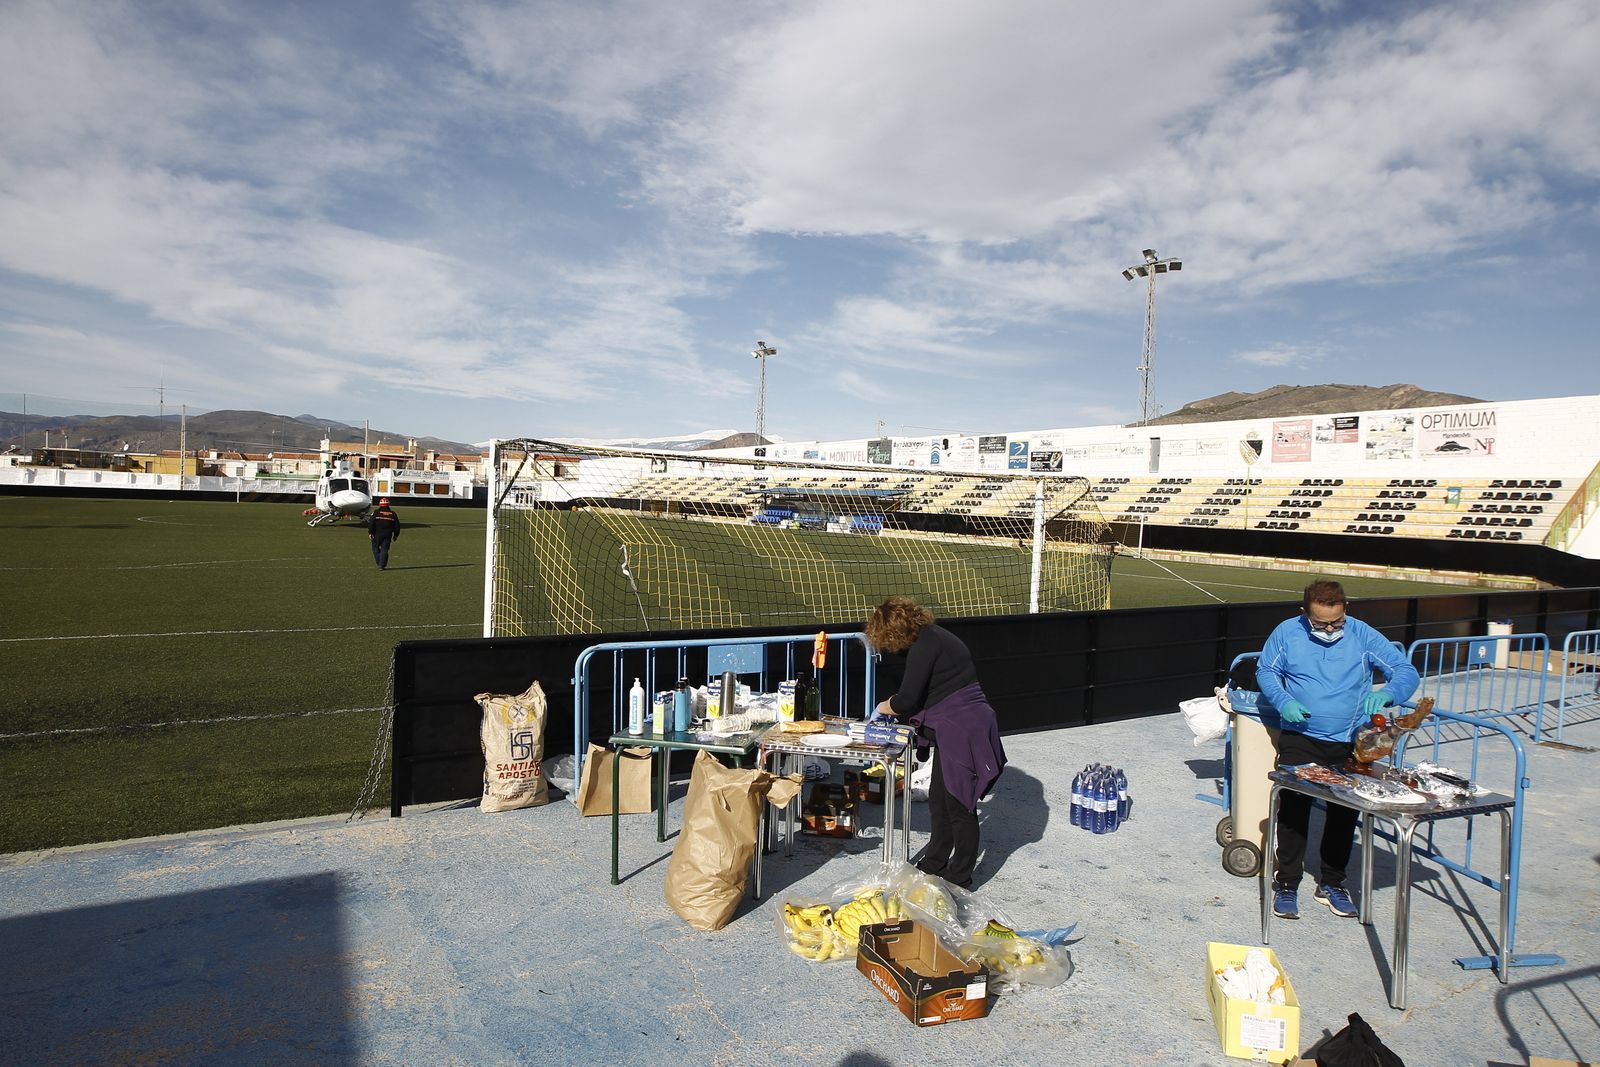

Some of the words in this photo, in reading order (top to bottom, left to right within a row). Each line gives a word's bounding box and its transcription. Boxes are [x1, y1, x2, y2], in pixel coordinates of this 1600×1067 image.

[1421, 411, 1496, 430] OPTIMUM
[829, 450, 865, 462] MONTIVEL
[870, 969, 900, 1003] ORCHARD
[942, 1005, 964, 1013] ORCHARD
